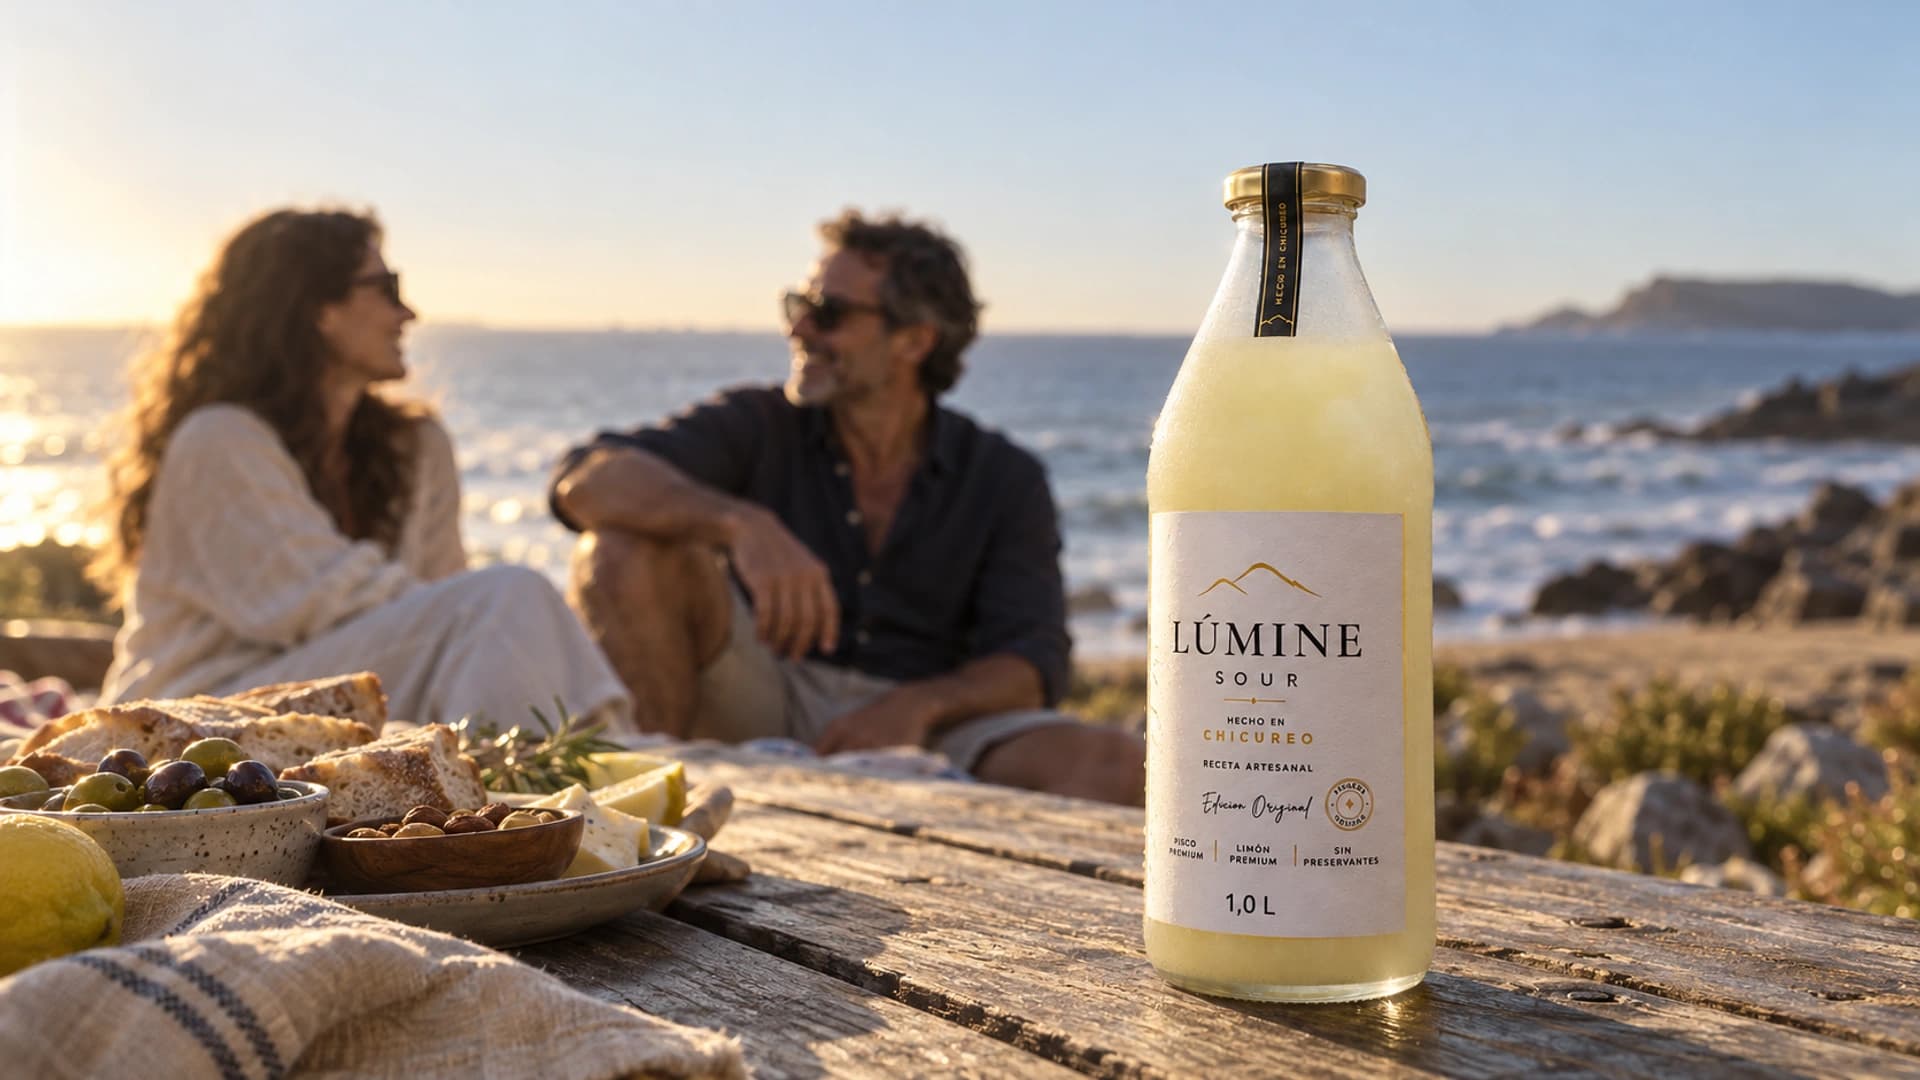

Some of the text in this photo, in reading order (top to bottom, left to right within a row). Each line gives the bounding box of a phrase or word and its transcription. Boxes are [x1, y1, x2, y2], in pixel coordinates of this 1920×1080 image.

[1278, 256, 1287, 269] EN
[1172, 613, 1362, 658] LÚMINE
[1215, 670, 1298, 687] SOUR
[1227, 716, 1285, 726] HECHO EN
[1203, 729, 1313, 745] CHICUREO
[1203, 760, 1313, 773] RECETA ARTESANAL
[1174, 837, 1197, 848] PISCO
[1169, 847, 1204, 860] PREMIUM
[1334, 846, 1351, 855] SIN
[1229, 855, 1277, 866] PREMIUM
[1303, 856, 1379, 867] PRESERVANTES
[1226, 893, 1275, 916] 1,0 L
